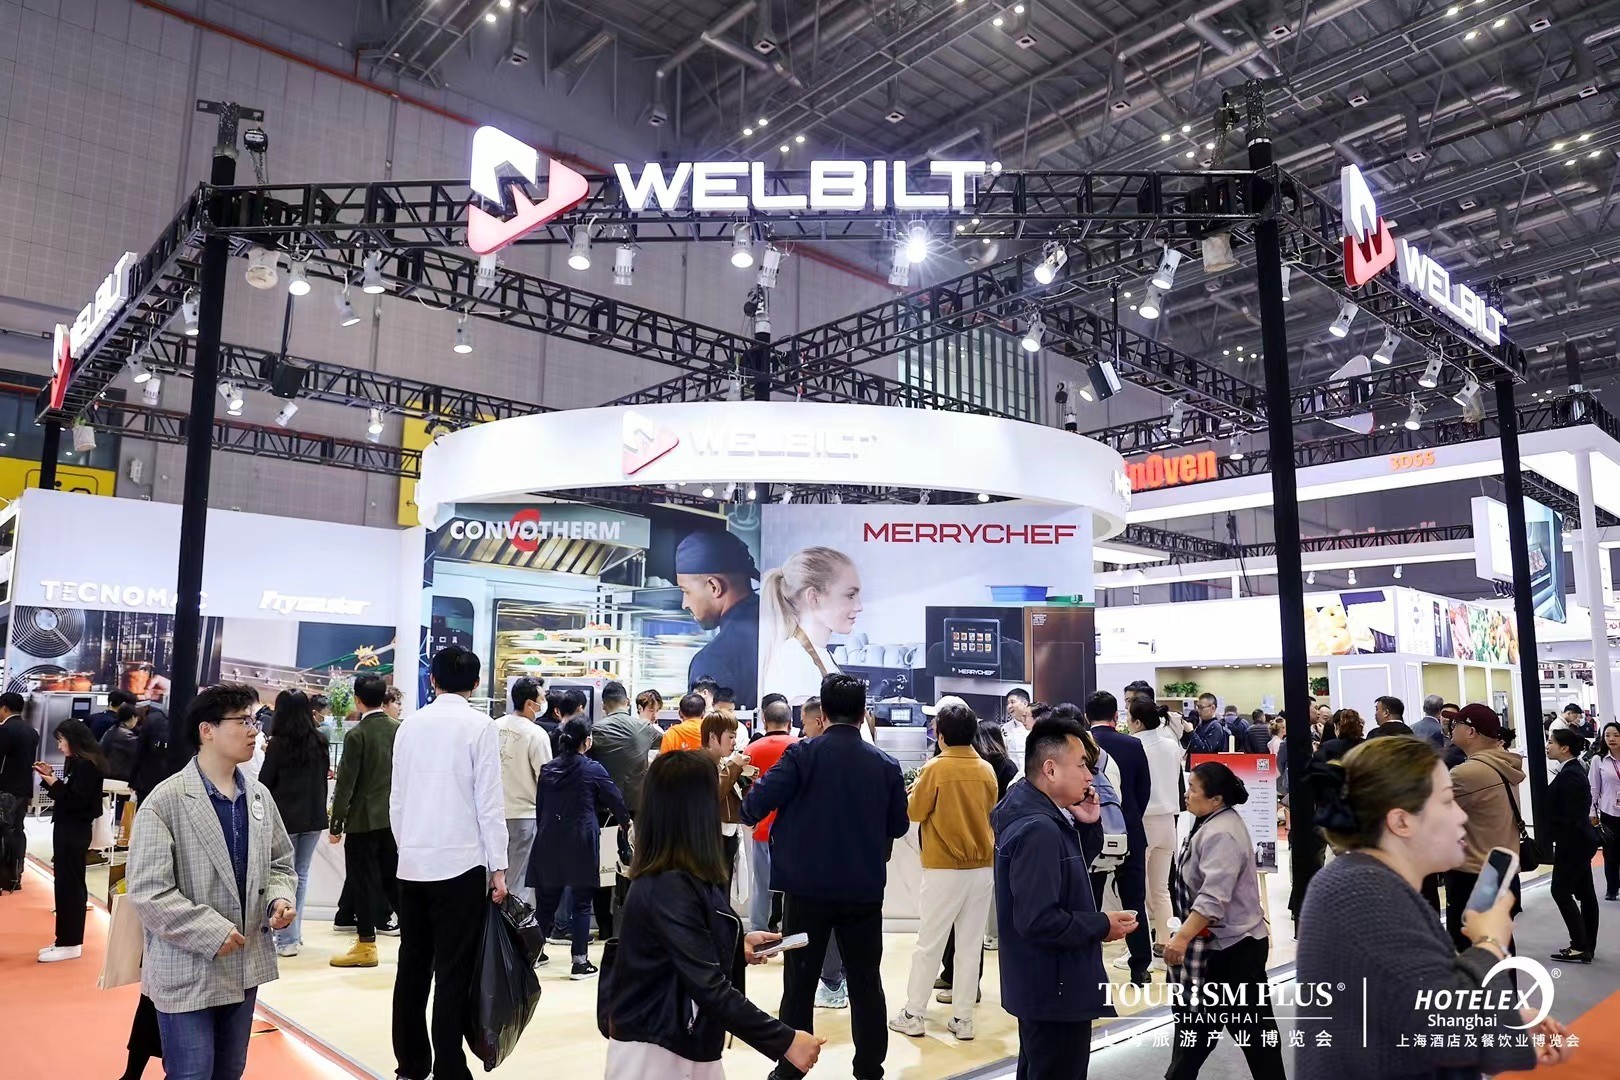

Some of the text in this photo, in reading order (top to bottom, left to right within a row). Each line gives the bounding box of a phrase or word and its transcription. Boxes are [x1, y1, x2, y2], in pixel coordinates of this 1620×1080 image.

[613, 160, 988, 212] WELBILT
[1395, 237, 1504, 347] WELBILT
[450, 520, 620, 541] CONVOTHERM
[863, 522, 1078, 545] MERRYCHEF
